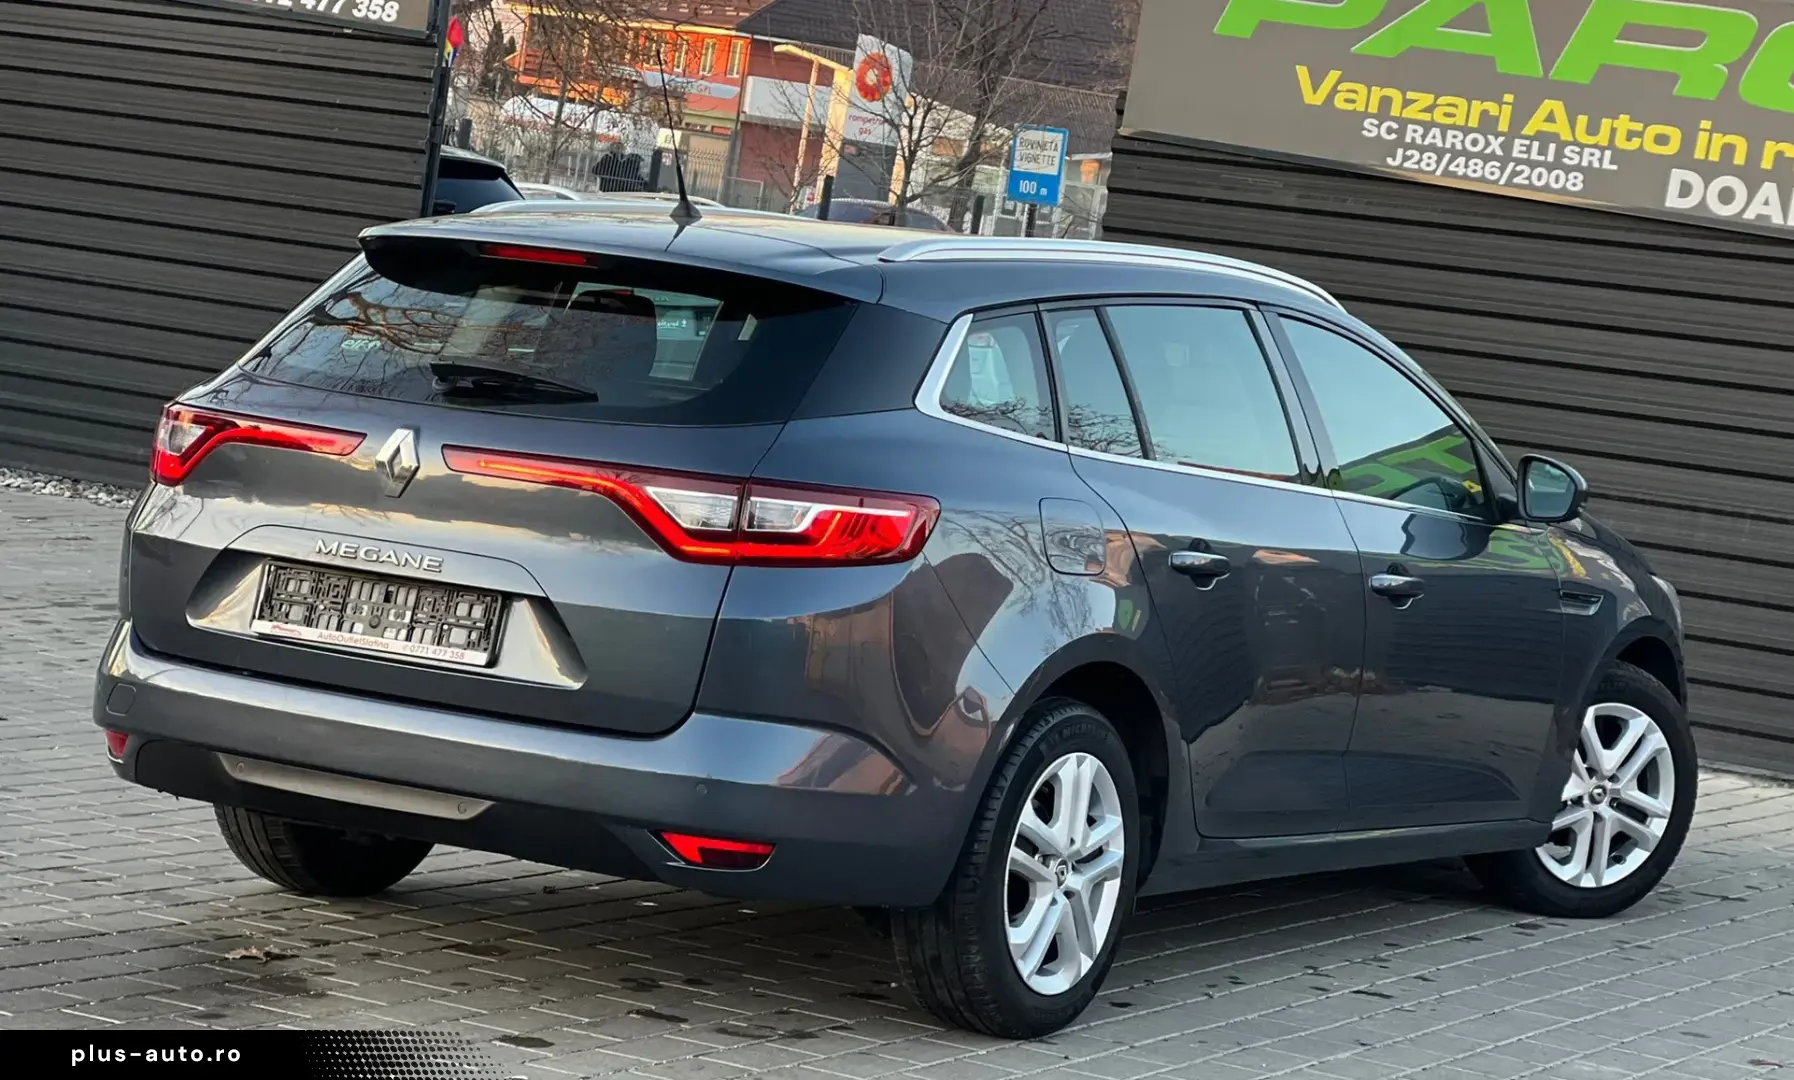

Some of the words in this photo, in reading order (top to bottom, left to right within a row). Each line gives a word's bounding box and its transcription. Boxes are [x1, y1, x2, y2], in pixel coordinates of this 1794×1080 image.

[351, 0, 401, 23] 358
[848, 114, 890, 127] rompetro
[1295, 64, 1515, 132] Vanzari
[1521, 98, 1683, 156] Auto
[1693, 119, 1749, 166] in
[1760, 140, 1794, 171] r
[858, 127, 872, 137] gas
[1361, 118, 1400, 140] SC
[1404, 123, 1506, 156] RAROX
[1512, 138, 1555, 163] ELI
[1562, 144, 1619, 171] SRL
[1018, 151, 1057, 166] VIGNETTE
[1386, 148, 1585, 192] J28/486/2008
[1019, 179, 1037, 194] 100
[1040, 187, 1048, 196] m
[1665, 168, 1794, 226] DOA
[315, 538, 444, 574] MEGANE
[409, 644, 430, 655] 0771
[431, 647, 449, 658] 477
[449, 649, 465, 661] 358
